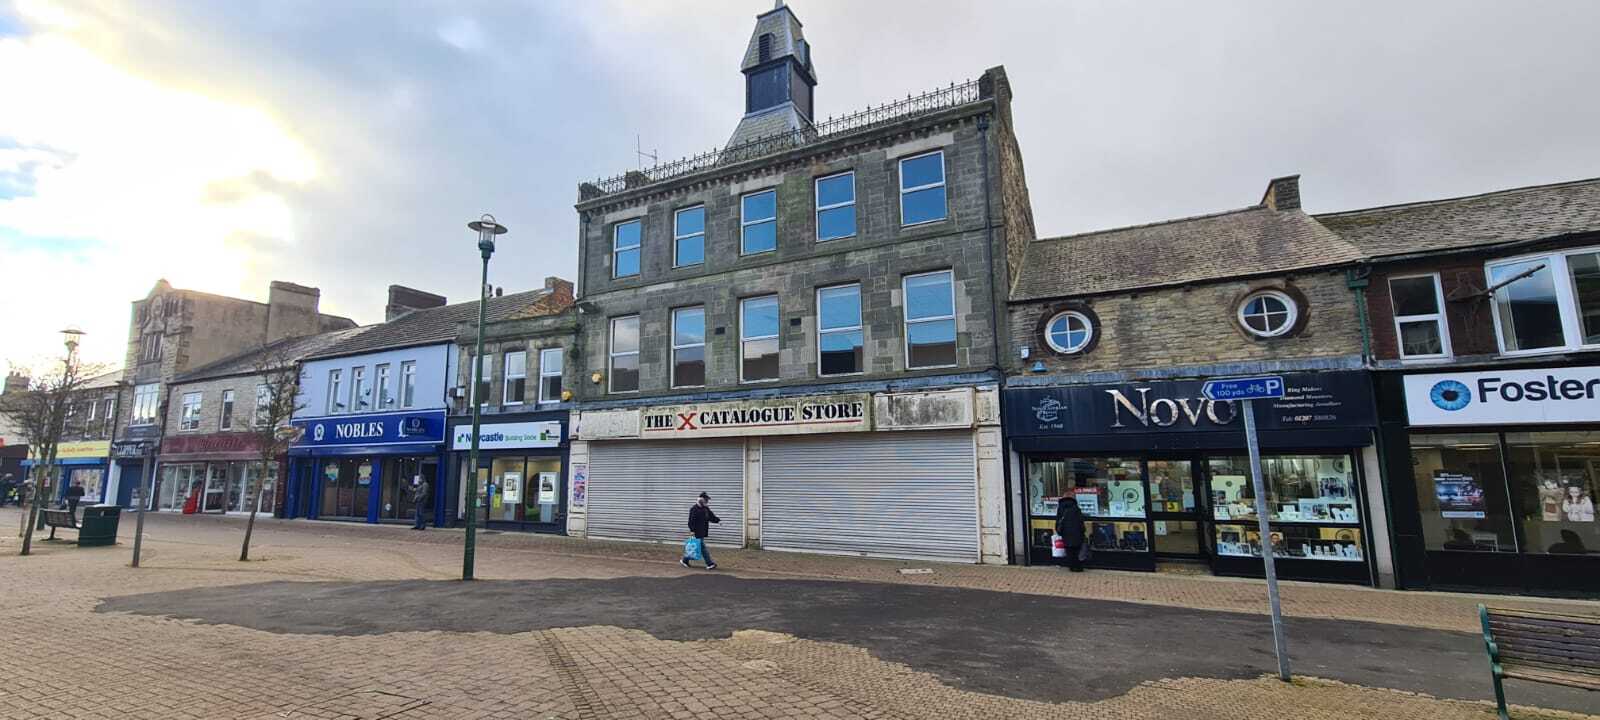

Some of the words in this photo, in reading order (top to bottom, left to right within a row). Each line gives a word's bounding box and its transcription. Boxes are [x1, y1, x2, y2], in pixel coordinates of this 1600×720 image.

[1232, 389, 1245, 397] yds
[1266, 380, 1280, 395] P
[1476, 375, 1600, 403] Foster
[644, 414, 673, 428] THE
[677, 412, 698, 431] X
[700, 407, 795, 426] CATALOGUE
[802, 402, 863, 420] STORE
[335, 421, 384, 439] NOBLES
